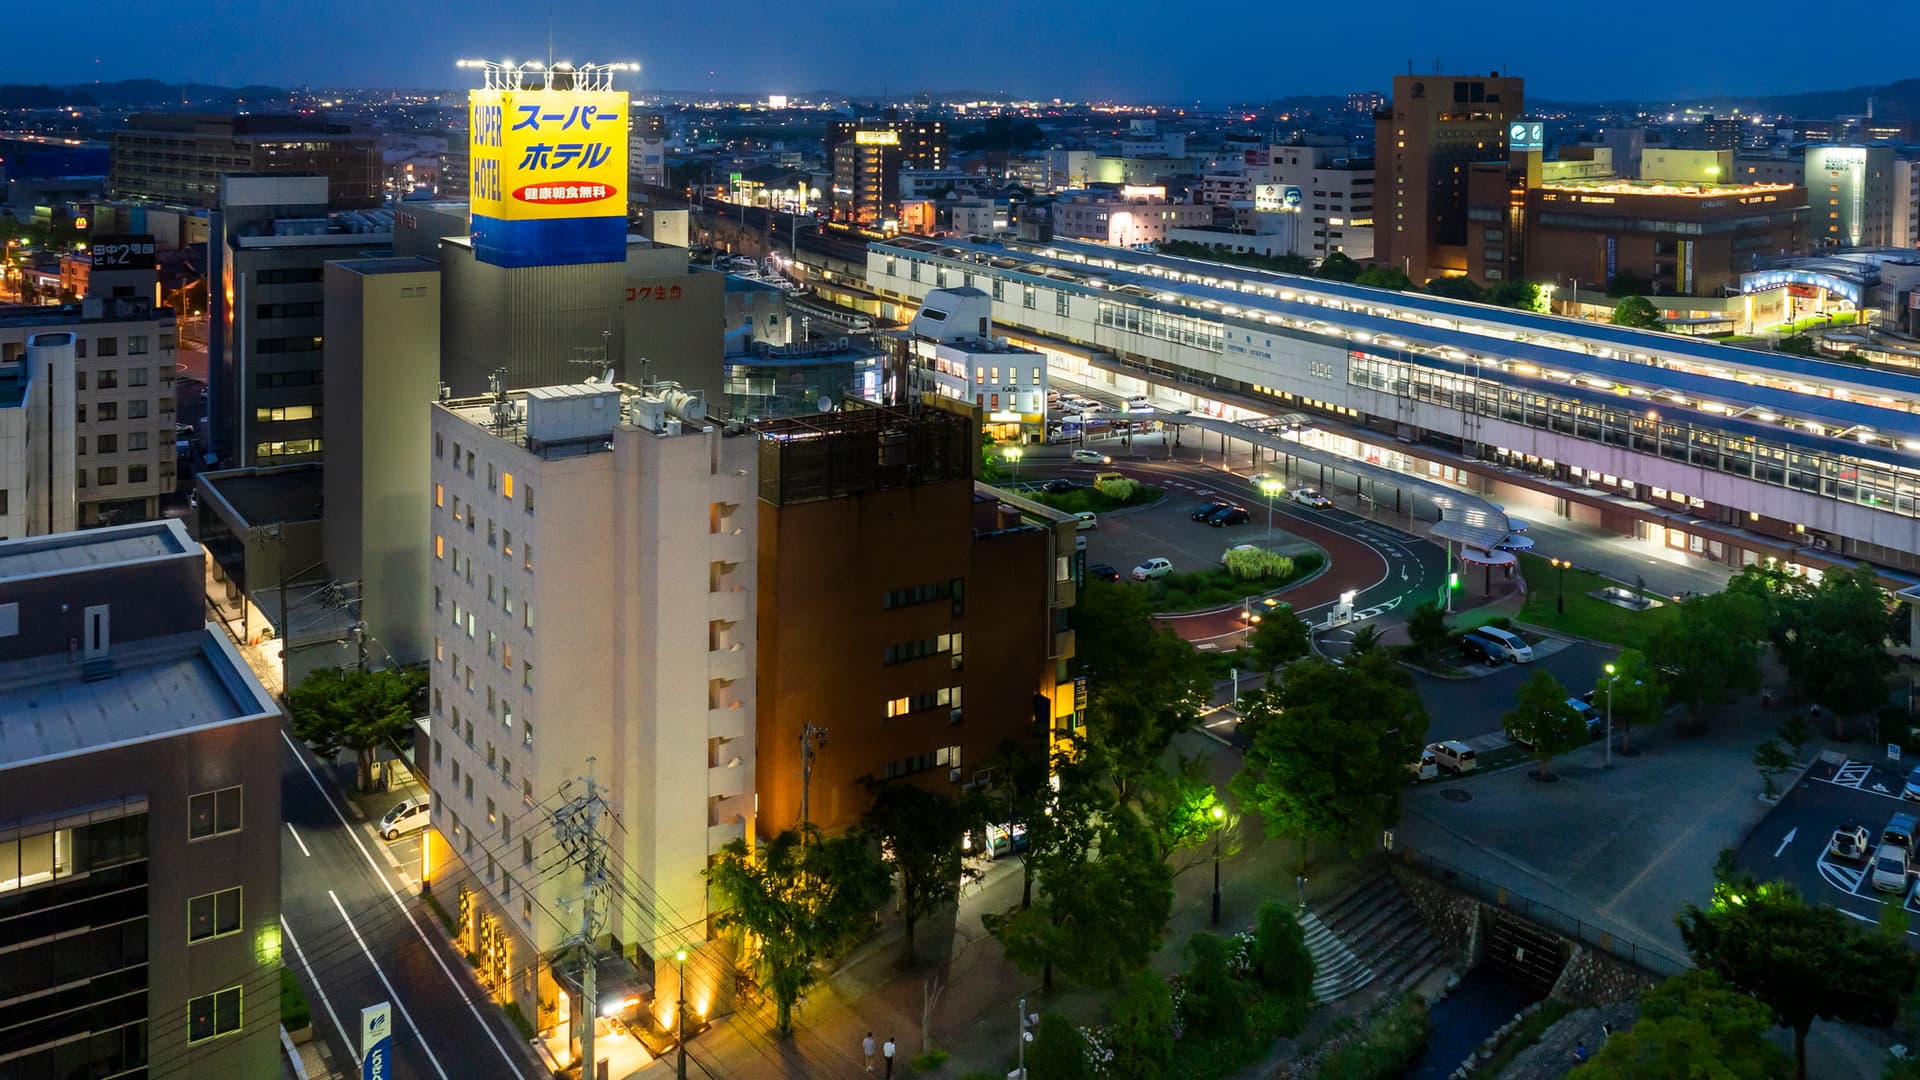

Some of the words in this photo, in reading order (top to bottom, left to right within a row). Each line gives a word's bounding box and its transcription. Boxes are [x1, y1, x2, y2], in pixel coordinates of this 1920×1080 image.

[474, 105, 502, 147] SUPER
[511, 105, 618, 131] スーパー
[518, 142, 612, 170] ホテル
[474, 157, 502, 201] HOTEL
[524, 186, 606, 200] 健康朝食無料
